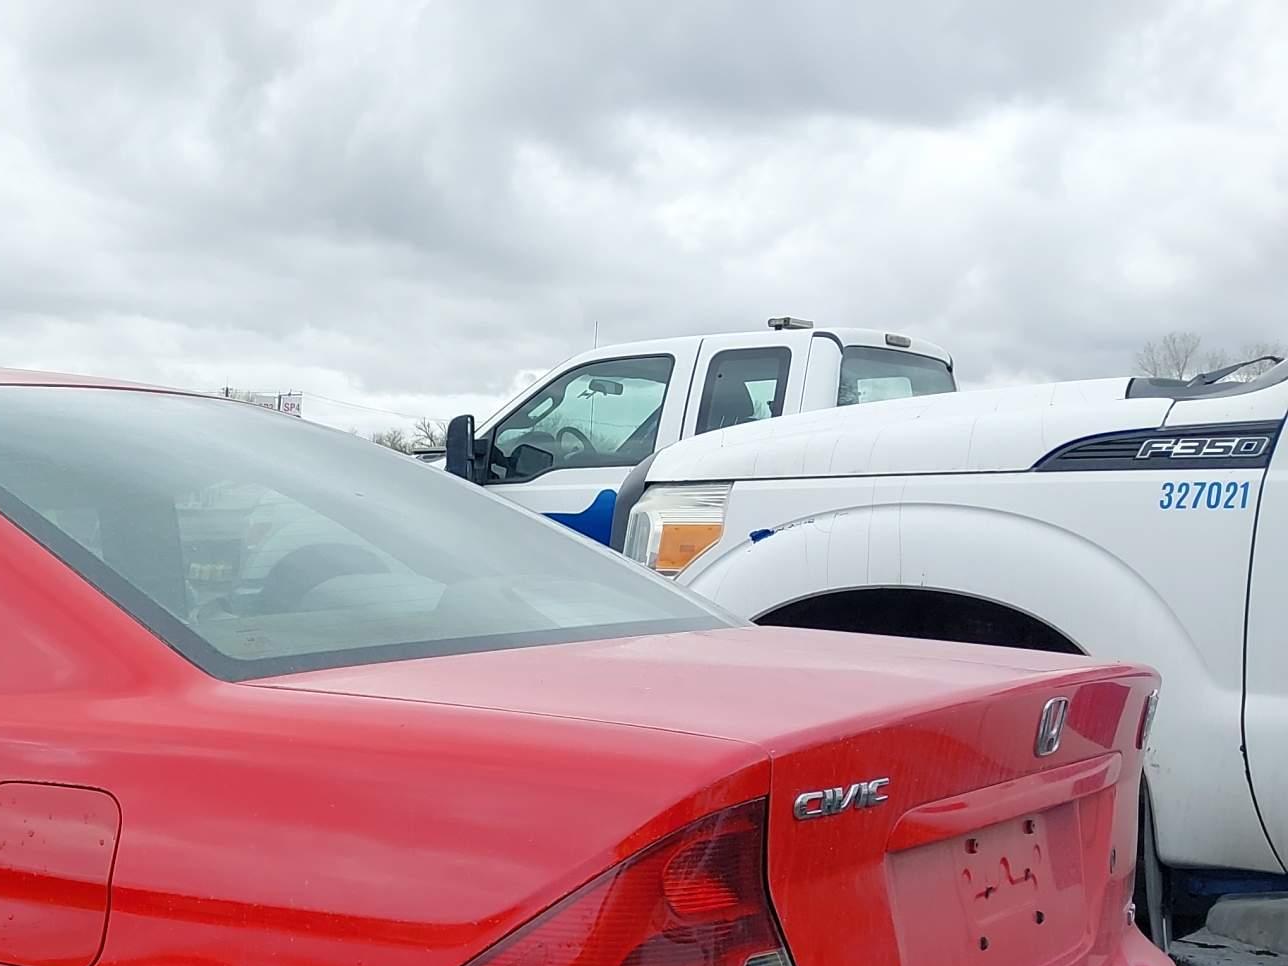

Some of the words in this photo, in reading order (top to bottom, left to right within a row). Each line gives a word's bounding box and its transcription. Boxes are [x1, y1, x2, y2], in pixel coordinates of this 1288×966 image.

[1136, 437, 1270, 459] F-350
[1159, 482, 1249, 509] 327021
[793, 778, 890, 820] CIVIC
